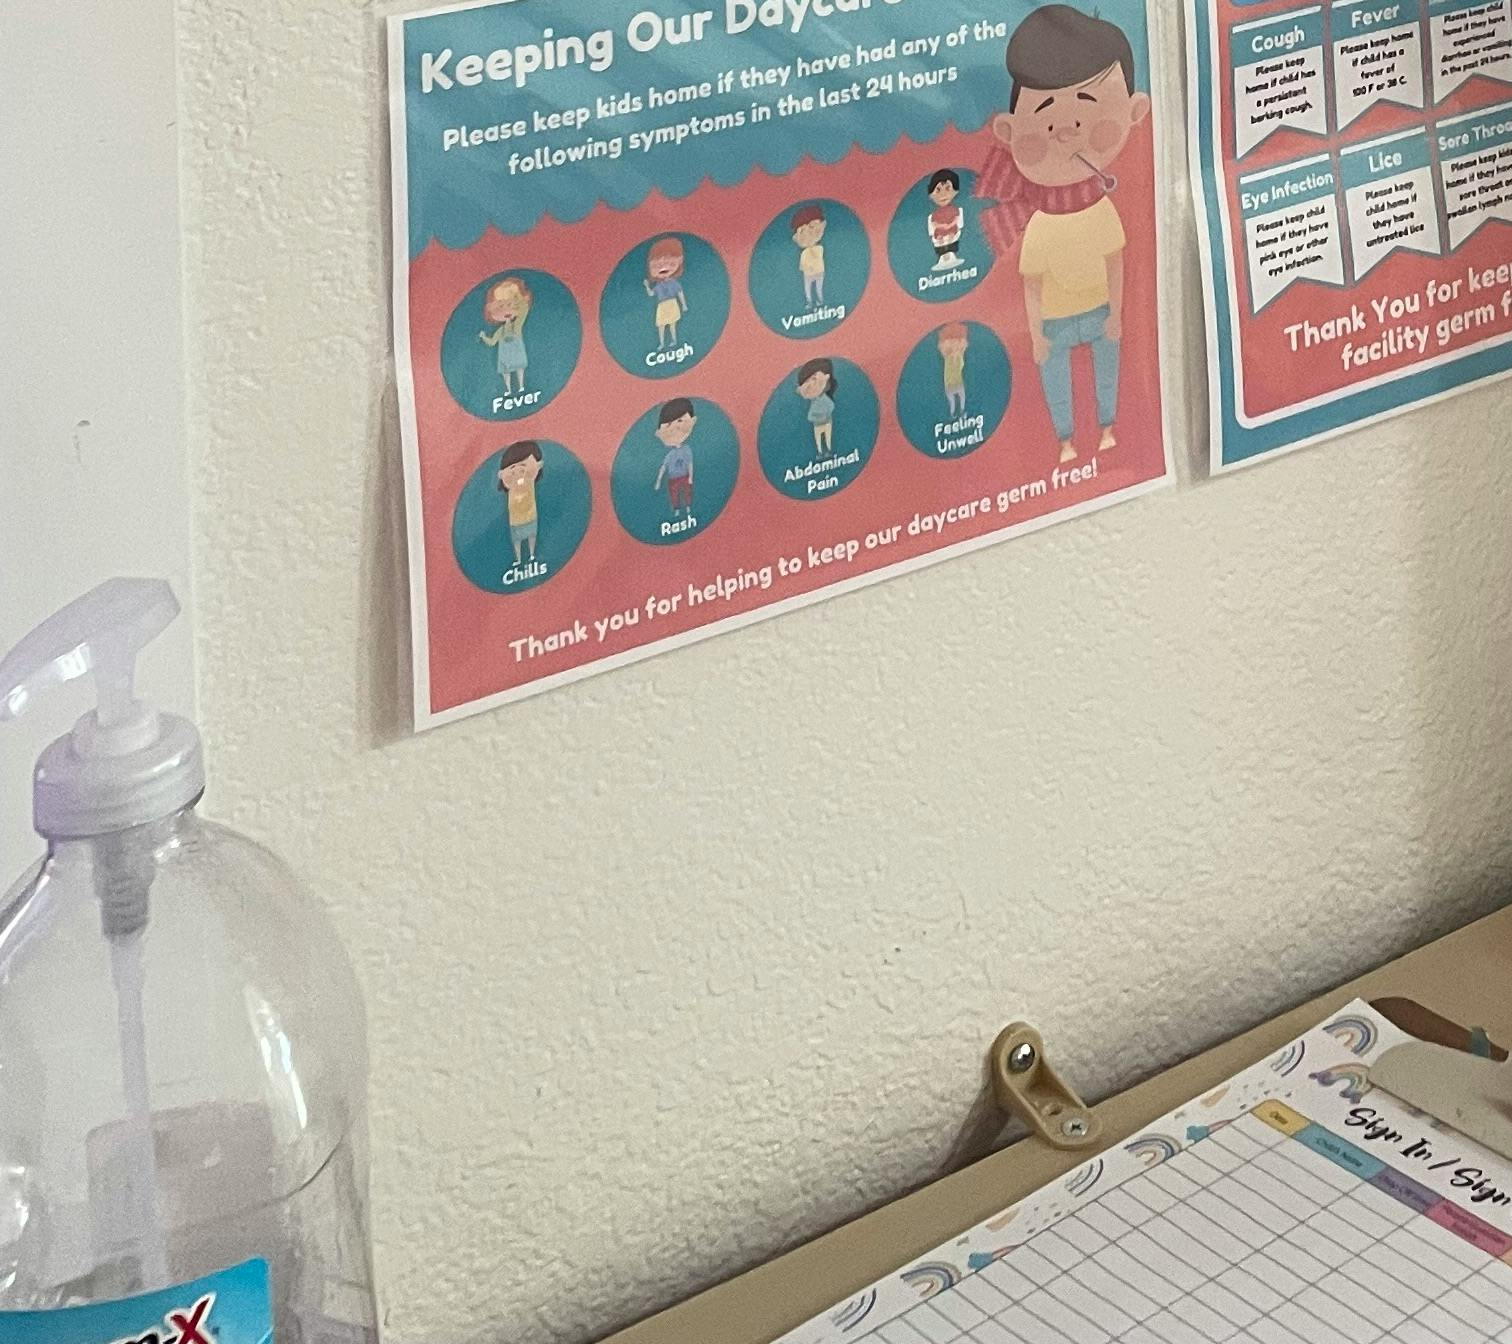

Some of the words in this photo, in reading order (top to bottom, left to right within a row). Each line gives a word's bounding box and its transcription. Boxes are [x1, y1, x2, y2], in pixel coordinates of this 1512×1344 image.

[1351, 5, 1399, 28] Fever
[421, 28, 614, 93] Keeping
[628, 11, 712, 51] Our
[1252, 25, 1305, 53] Cough
[1341, 43, 1368, 55] Please
[1256, 64, 1283, 77] Please
[443, 121, 526, 151] Please
[533, 106, 590, 133] keep
[597, 92, 642, 119] kids
[649, 81, 711, 108] home
[717, 71, 734, 94] if
[740, 64, 791, 89] they
[797, 53, 851, 78] have
[856, 40, 896, 66] had
[902, 34, 940, 59] any
[946, 23, 968, 46] of
[974, 20, 1006, 41] the
[508, 138, 622, 174] following
[629, 110, 745, 152] symptoms
[752, 102, 771, 123] in
[777, 89, 813, 116] the
[820, 84, 860, 108] last
[866, 76, 893, 98] 24
[899, 66, 958, 90] hours
[1439, 133, 1469, 151] Sore
[1369, 152, 1402, 172] Lice
[1242, 192, 1269, 210] Eye
[1272, 173, 1333, 200] Infection
[918, 266, 978, 292] Diarrhea
[781, 303, 846, 331] Vomiting
[1284, 304, 1366, 352] Thank
[1371, 292, 1419, 323] You
[1425, 275, 1462, 307] for
[1341, 326, 1429, 370] facility
[1436, 302, 1495, 346] germ
[645, 344, 694, 366] Cough
[492, 389, 542, 413] Fever
[934, 413, 984, 439] Feeling
[937, 429, 984, 453] Unwell
[784, 449, 860, 482] Abdominal
[807, 474, 839, 494] Pain
[661, 515, 697, 536] Rash
[509, 620, 588, 662] Thank
[594, 607, 639, 642] you
[645, 594, 682, 619] for
[688, 568, 772, 606] helping
[778, 556, 802, 576] to
[808, 540, 859, 568] keep
[865, 525, 901, 549] our
[908, 496, 991, 536] daycare
[997, 478, 1046, 512] germ
[1052, 456, 1098, 490] free!
[502, 561, 547, 585] Chills
[1344, 1106, 1402, 1143] Sign
[1400, 1137, 1432, 1160] In
[1450, 1168, 1512, 1206] Sign
